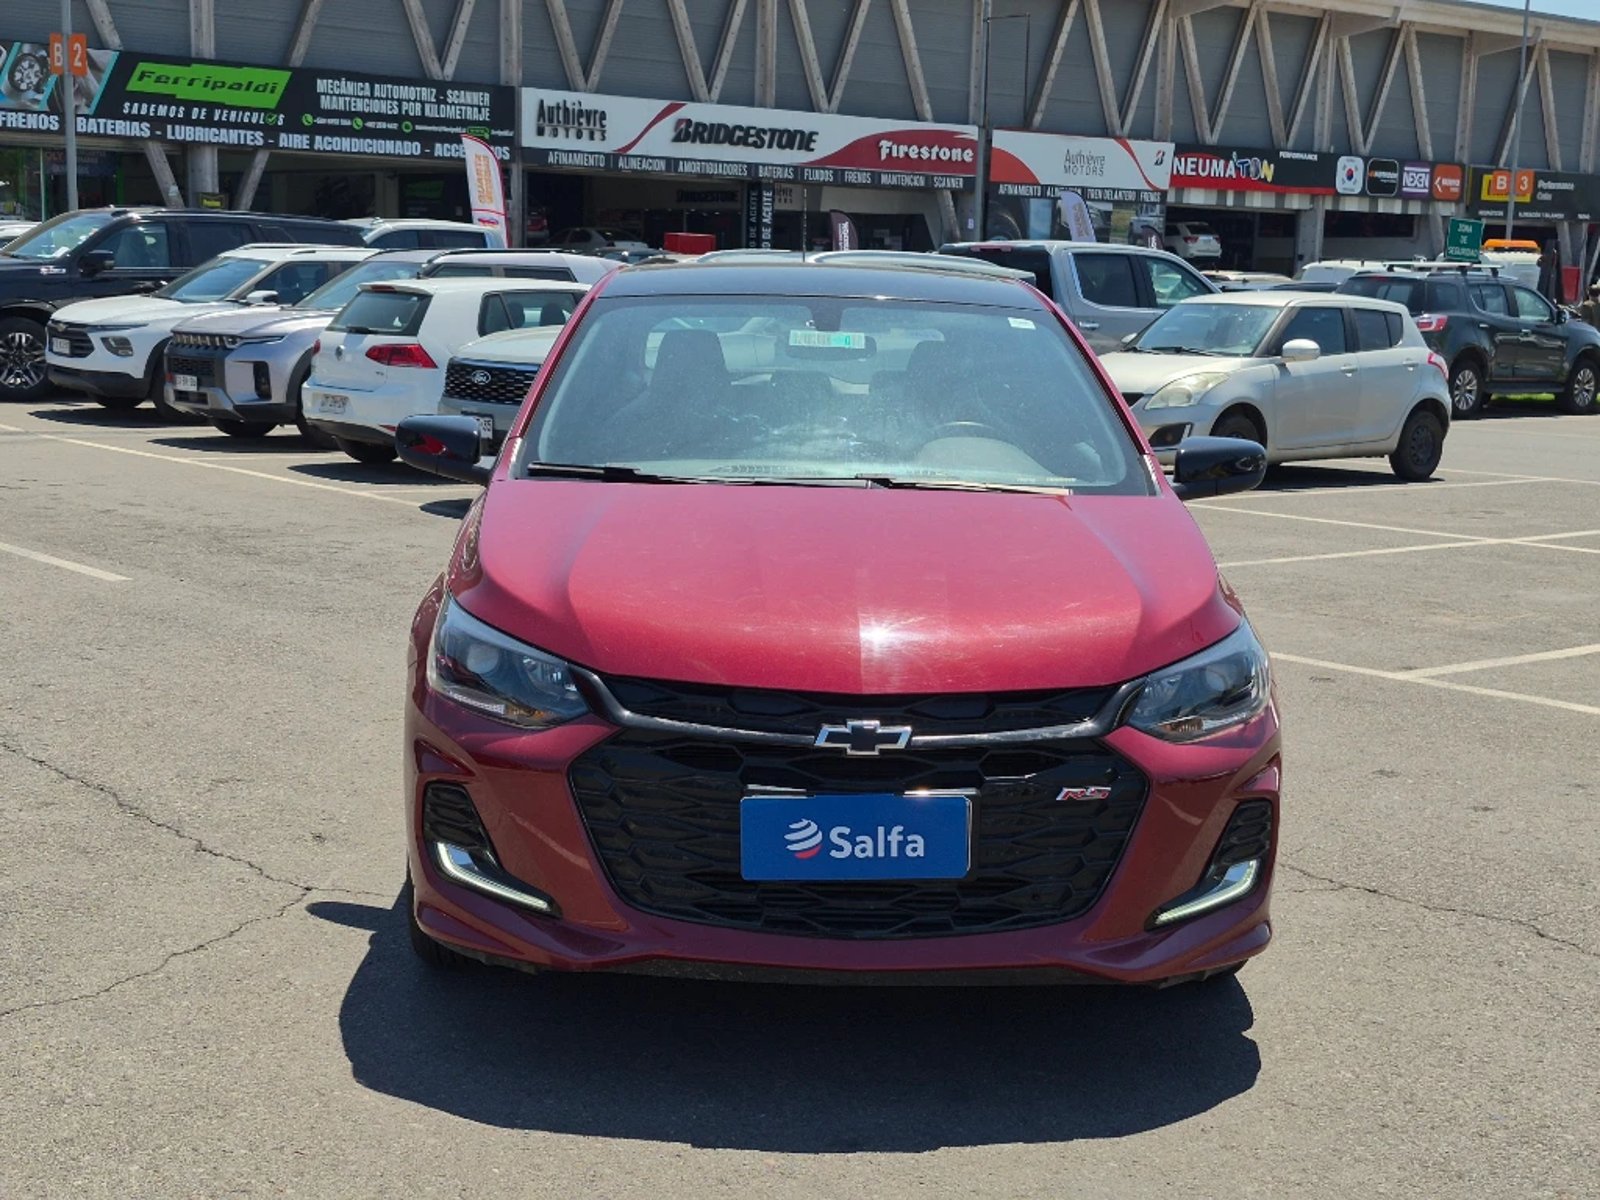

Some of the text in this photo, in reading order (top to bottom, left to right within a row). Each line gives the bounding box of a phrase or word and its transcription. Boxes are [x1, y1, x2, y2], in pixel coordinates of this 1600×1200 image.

[54, 43, 82, 68] B 2
[137, 70, 279, 94] Ferripaldi
[317, 78, 371, 98] MECÁNICA
[374, 83, 436, 103] AUTOMOTRIZ
[447, 89, 490, 107] SCANNER
[123, 102, 185, 118] SABEMOS
[191, 107, 207, 120] DE
[320, 95, 490, 121] MANTENCIONES POR KILOMETRAJE
[536, 99, 607, 128] Authièvre
[0, 112, 59, 131] FRENOS
[76, 118, 151, 138] BATERIAS
[167, 124, 264, 146] LUBRICANTES
[279, 133, 310, 149] AIRE
[314, 135, 421, 156] ACONDICIONADO
[434, 143, 511, 160] ACCEOS
[537, 126, 607, 141] MOTORS
[671, 118, 819, 152] BRIDGESTONE
[878, 139, 974, 163] Firestone
[548, 151, 605, 168] AFINAMIENTO
[618, 156, 667, 172] ALINEACION
[677, 160, 748, 176] AMORTIGUADORES
[759, 166, 794, 179] BATERIAS
[844, 171, 872, 184] FRENOS
[933, 176, 964, 189] SCANNER
[1064, 164, 1105, 176] MOTORS
[1496, 175, 1529, 191] B 3
[762, 190, 773, 224] ACEITE
[829, 825, 925, 859] Salfa
